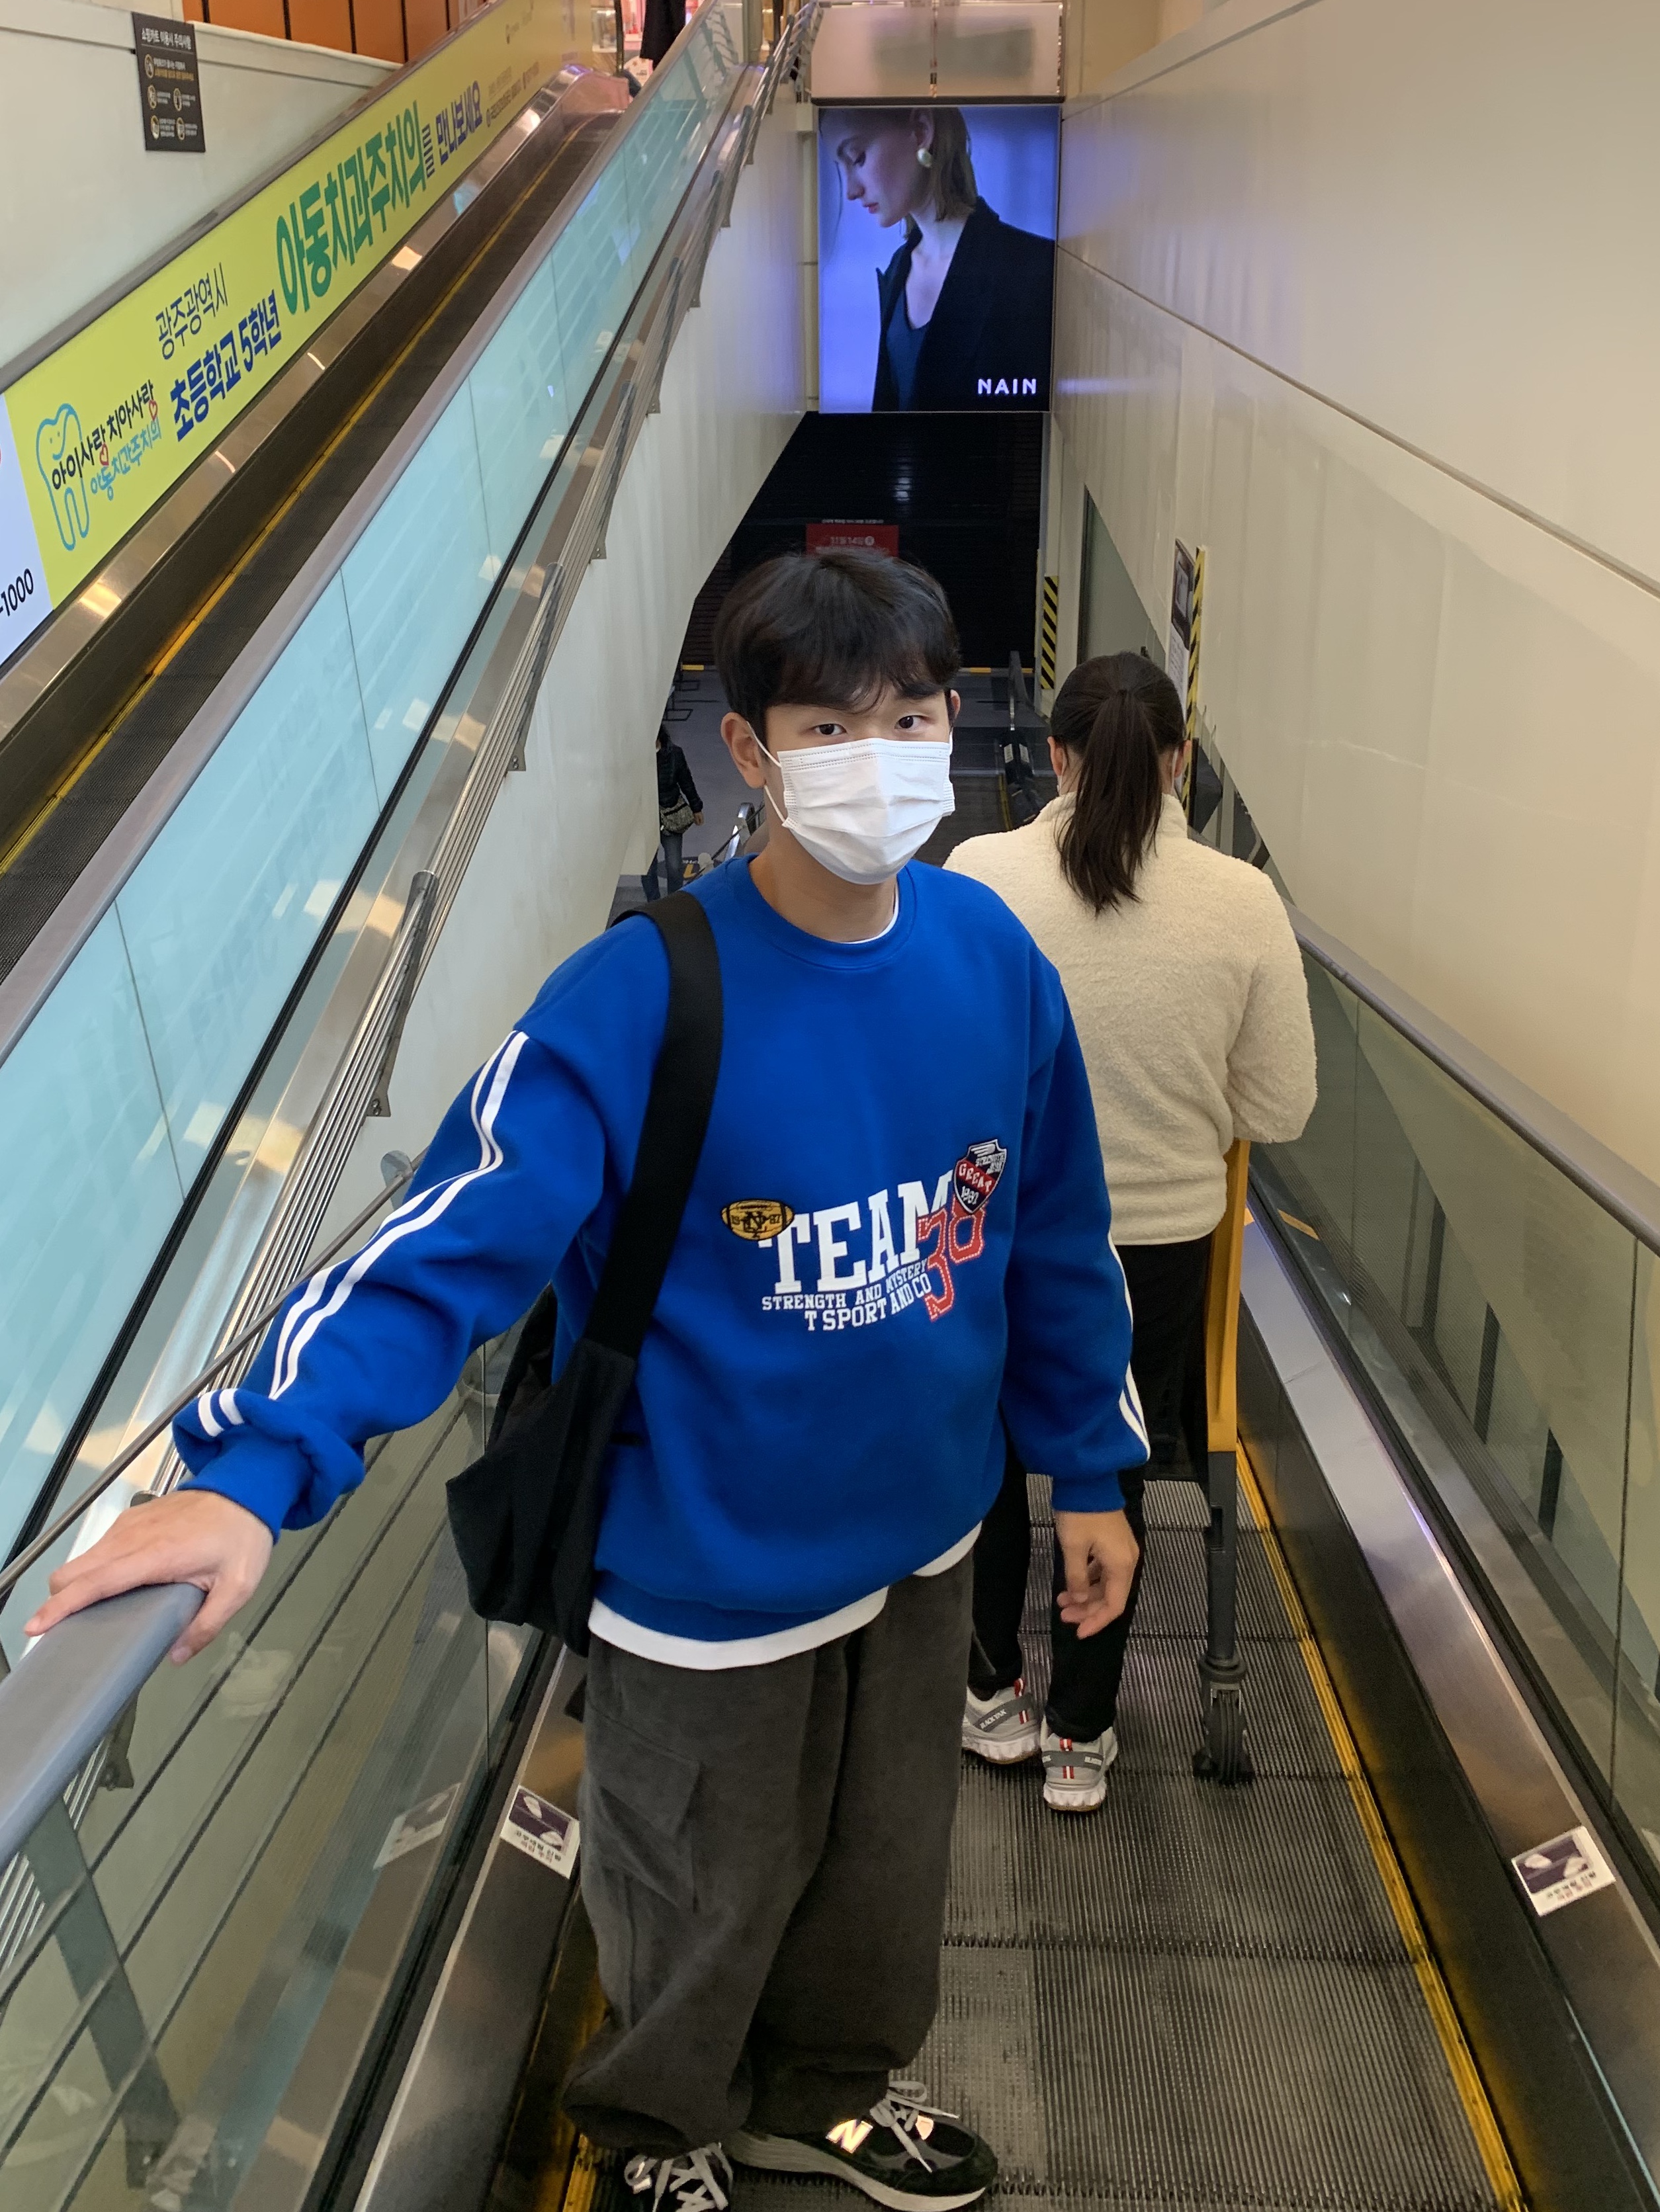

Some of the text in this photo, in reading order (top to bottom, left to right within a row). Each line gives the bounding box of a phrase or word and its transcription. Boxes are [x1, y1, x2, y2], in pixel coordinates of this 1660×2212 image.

[436, 80, 483, 165] 만나보세요
[155, 262, 228, 360] 광주광역시
[170, 288, 282, 442] 초등학교 5학년
[978, 378, 1037, 394] NAIN
[959, 1163, 992, 1193] GREAT
[758, 1170, 953, 1295] TEAM
[762, 1258, 928, 1311] STRENGTH AND MYSTERY
[805, 1310, 817, 1331] T
[822, 1298, 887, 1330] SPORT
[891, 1282, 914, 1315] AND
[826, 2119, 874, 2154] N
